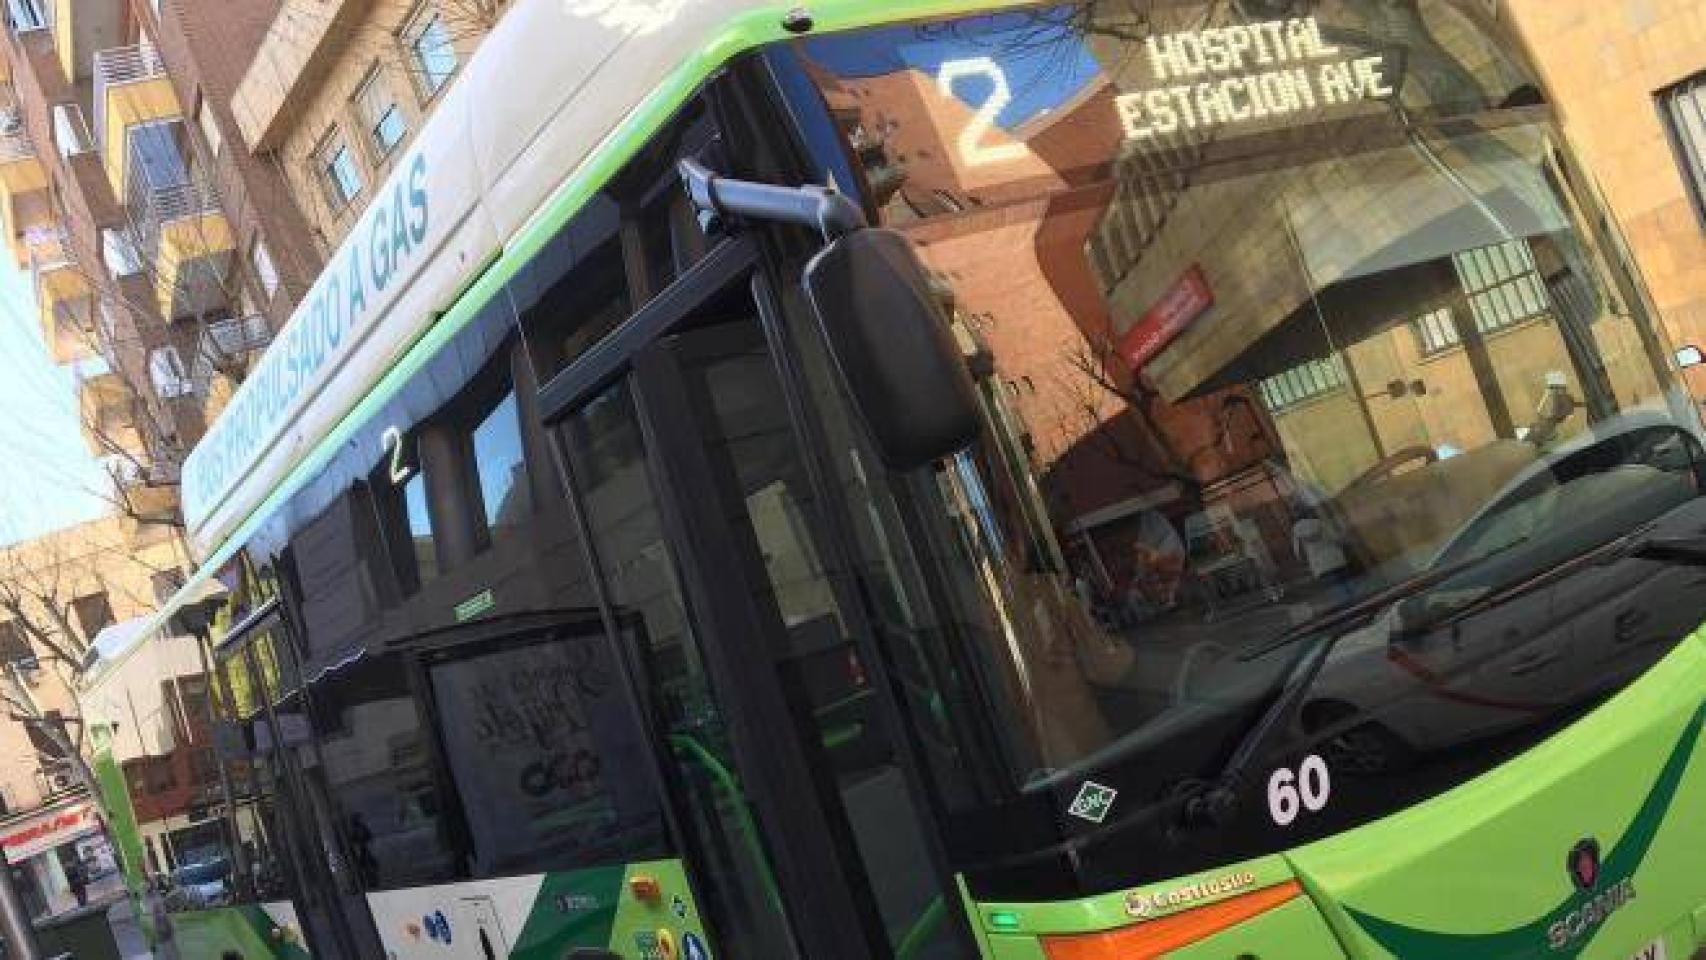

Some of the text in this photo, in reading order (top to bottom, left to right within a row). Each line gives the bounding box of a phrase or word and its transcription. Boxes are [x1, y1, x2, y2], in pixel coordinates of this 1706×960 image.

[1146, 17, 1339, 78] HOSPITAL
[938, 57, 1029, 166] 2
[1115, 56, 1393, 138] ESTACION AVE
[350, 244, 367, 316] A
[370, 153, 429, 291] GAS
[383, 425, 410, 484] 2
[1267, 754, 1331, 825] 60
[1548, 876, 1637, 949] SCANIA
